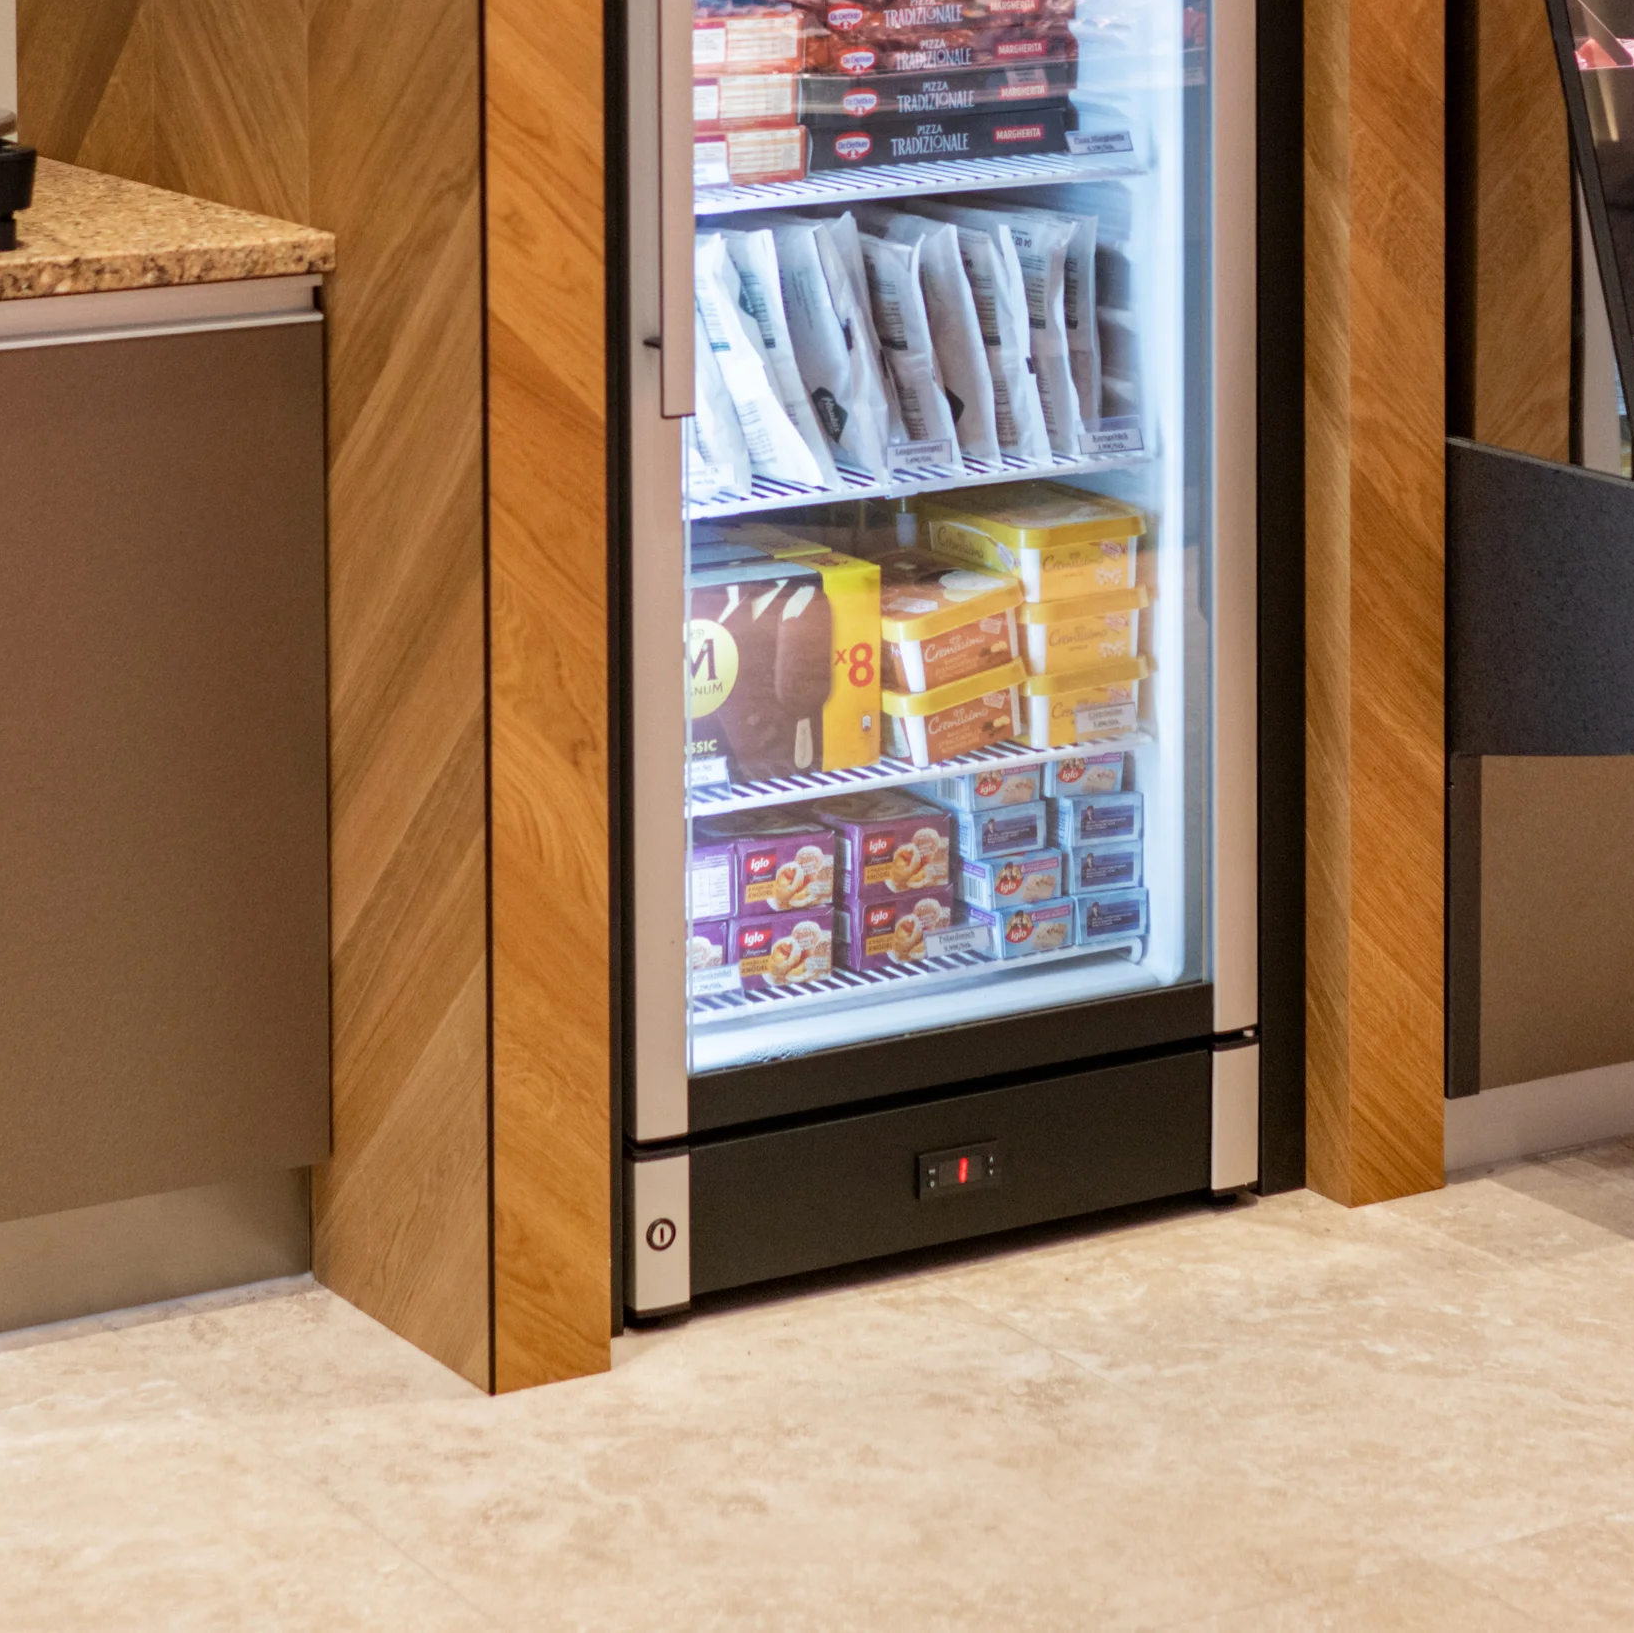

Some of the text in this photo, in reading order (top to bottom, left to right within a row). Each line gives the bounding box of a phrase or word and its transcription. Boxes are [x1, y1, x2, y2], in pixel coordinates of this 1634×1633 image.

[990, 0, 1036, 11] MARGHERITA
[883, 5, 963, 28] TRADIZIONALE
[921, 39, 946, 49] PIZZA
[998, 42, 1043, 55] MARGHERITA
[895, 48, 972, 71] TRADIZIONALE
[923, 81, 948, 92] PIZZA
[1001, 85, 1045, 97] MARGHERITA
[897, 90, 976, 114] TRADIZIONALE
[918, 124, 943, 135] PIZZA
[996, 127, 1041, 140] MARGHERITA
[891, 132, 970, 157] TRADIZIONALE
[924, 635, 986, 663] Cremissimo
[834, 642, 875, 688] x8
[928, 708, 988, 736] Cremissimo
[1062, 768, 1078, 783] iglo
[981, 782, 996, 797] iglo
[869, 839, 887, 854] iglo
[750, 857, 770, 871] iglo
[1000, 879, 1016, 895] iglo
[871, 910, 889, 924] iglo
[744, 931, 765, 945] iglo
[1011, 928, 1026, 943] iglo
